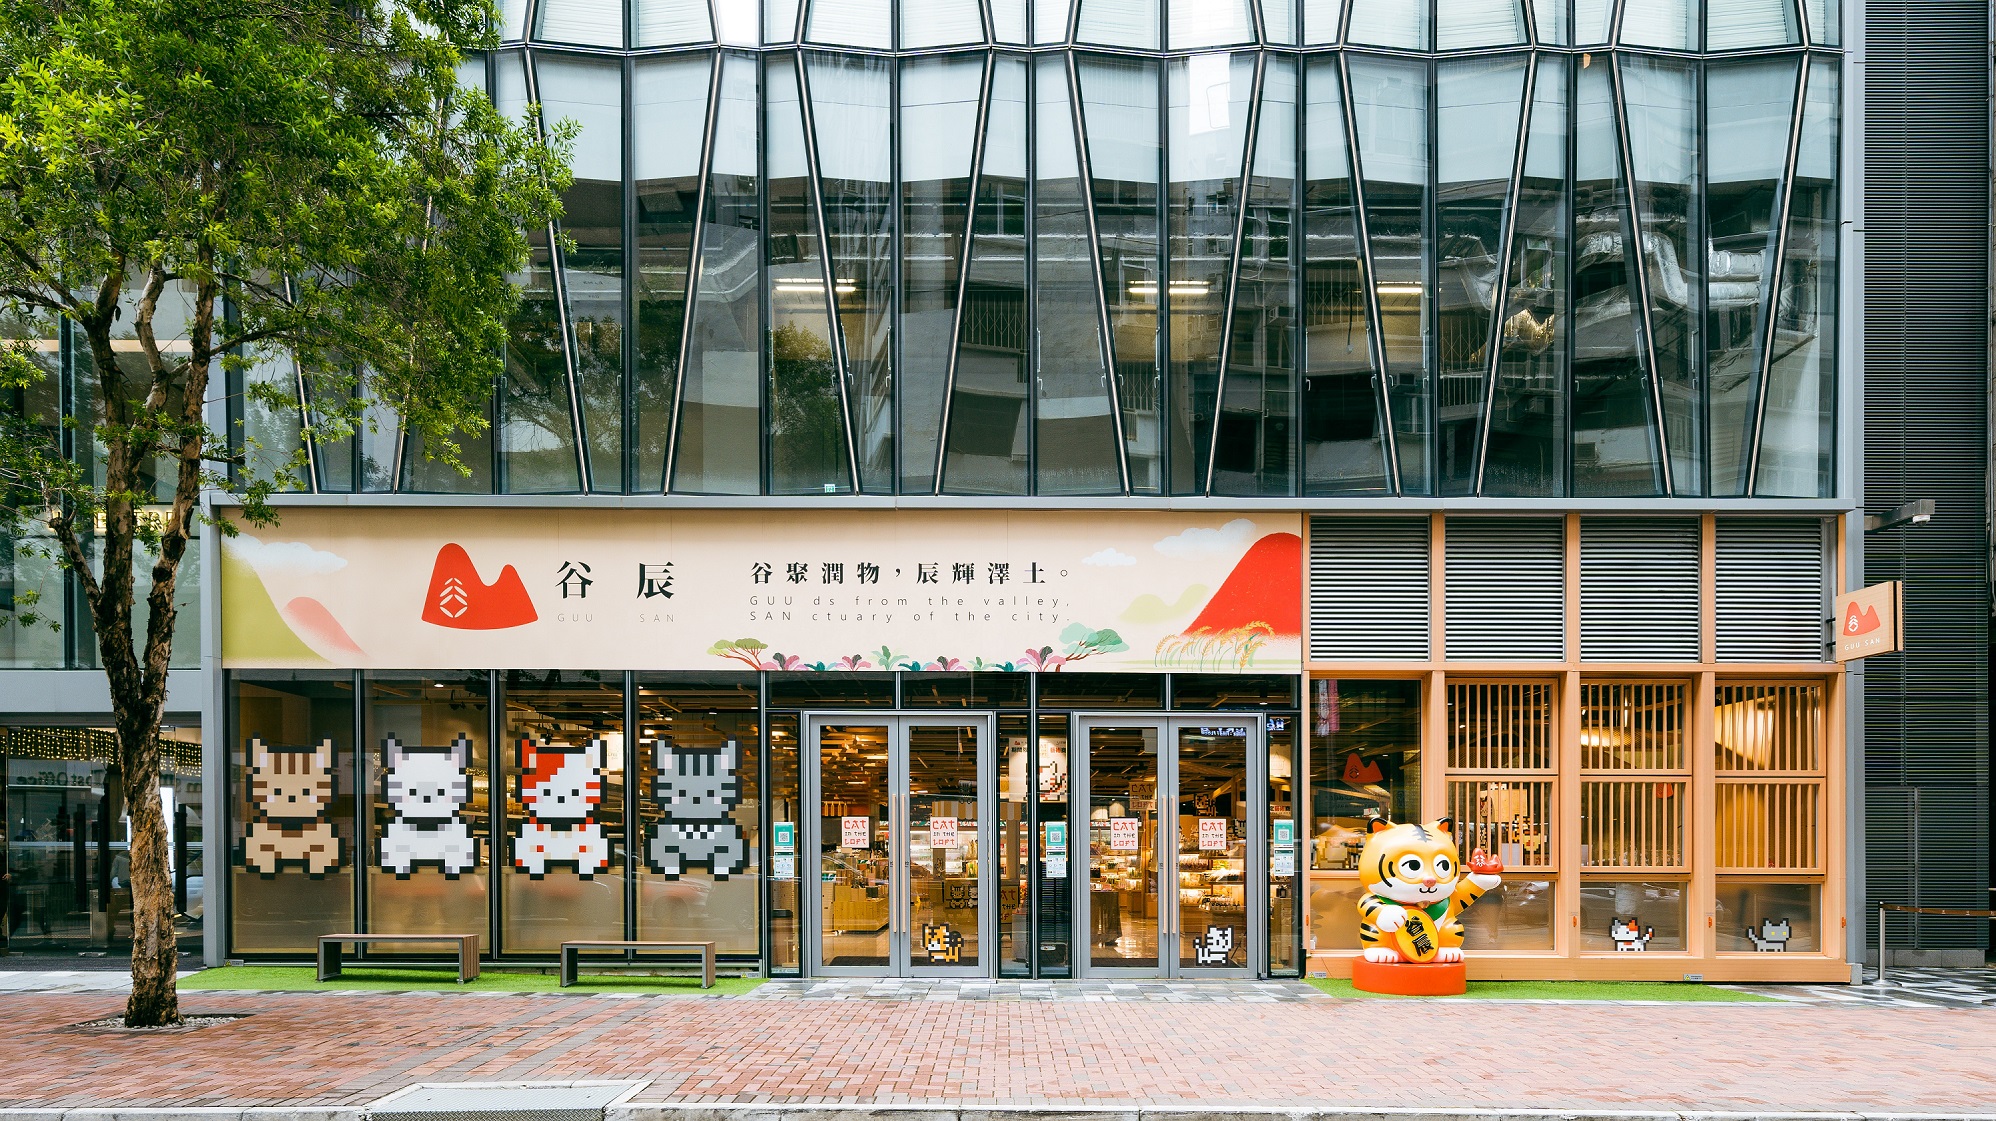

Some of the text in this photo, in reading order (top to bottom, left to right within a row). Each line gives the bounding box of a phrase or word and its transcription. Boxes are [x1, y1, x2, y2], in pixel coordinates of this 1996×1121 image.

[749, 595, 1070, 609] GUU ds from the valley,
[557, 613, 675, 623] GUU SAN
[749, 611, 1070, 624] SAN ctuary of the city.
[1845, 638, 1880, 651] GUU SAN
